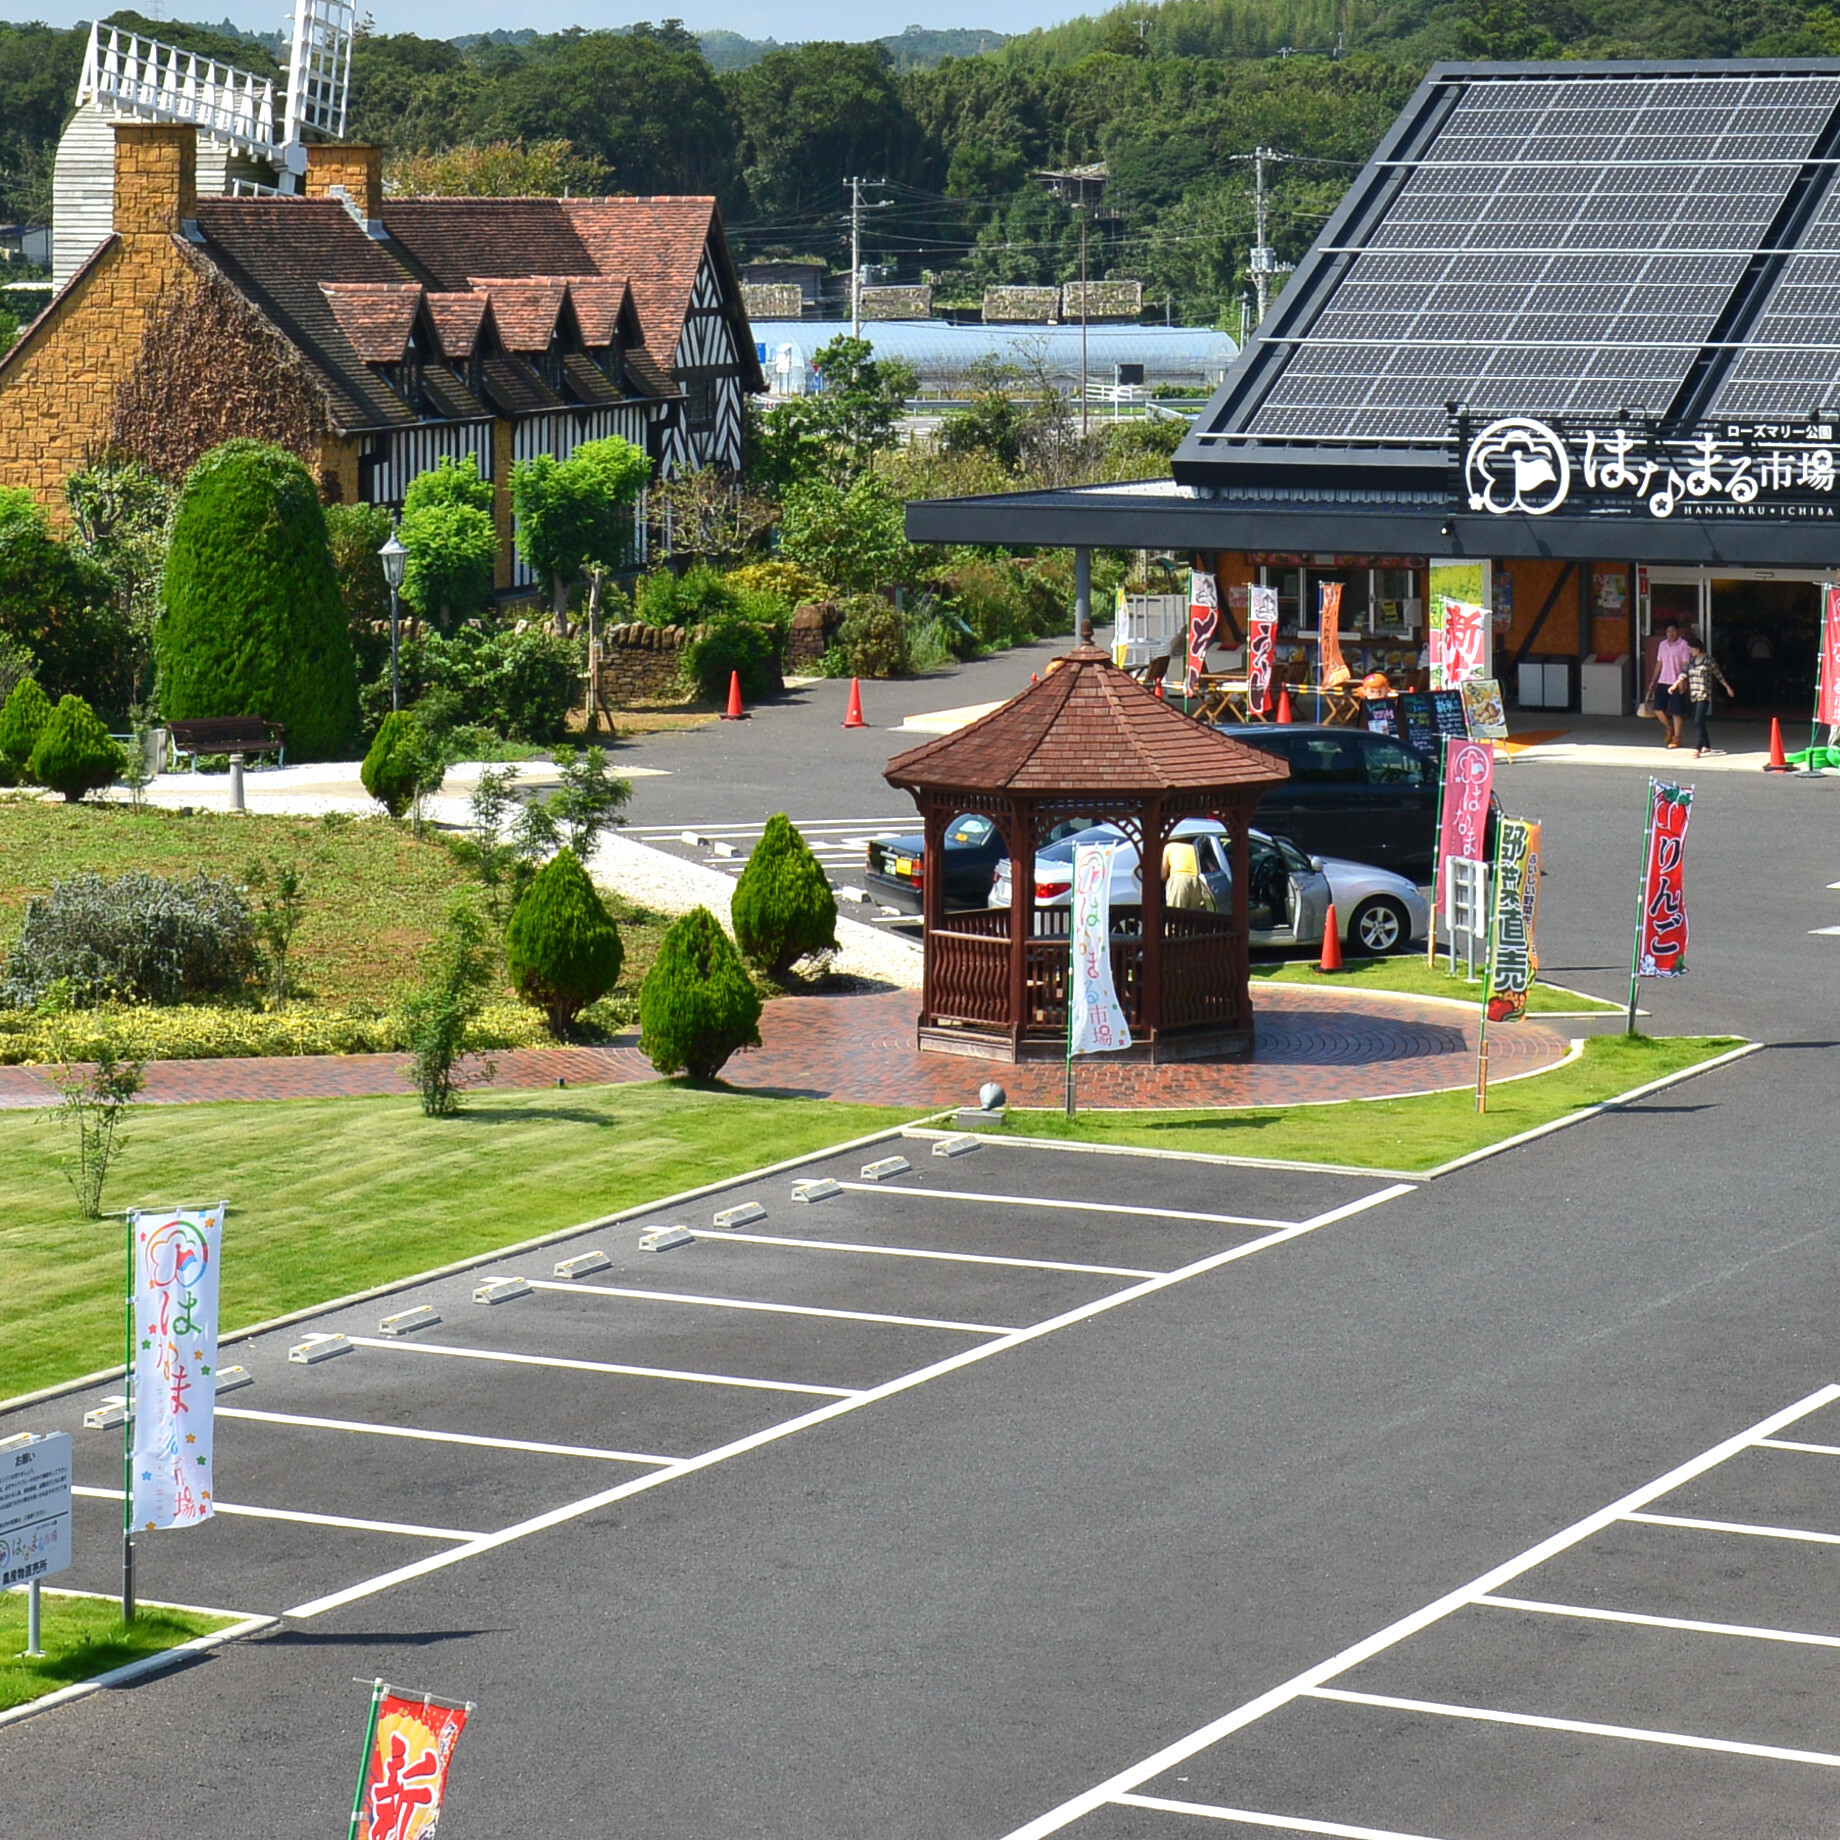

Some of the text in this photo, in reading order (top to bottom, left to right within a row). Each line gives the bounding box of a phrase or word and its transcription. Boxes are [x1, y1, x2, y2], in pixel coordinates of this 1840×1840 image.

[1727, 424, 1833, 441] ローズマリー公園
[1584, 429, 1836, 518] はなまる市場
[1683, 505, 1835, 517] HANAMARU ICHIBA
[1452, 784, 1481, 856] はなま
[1649, 836, 1683, 956] りんご
[2, 1558, 48, 1586] 農産物直売所
